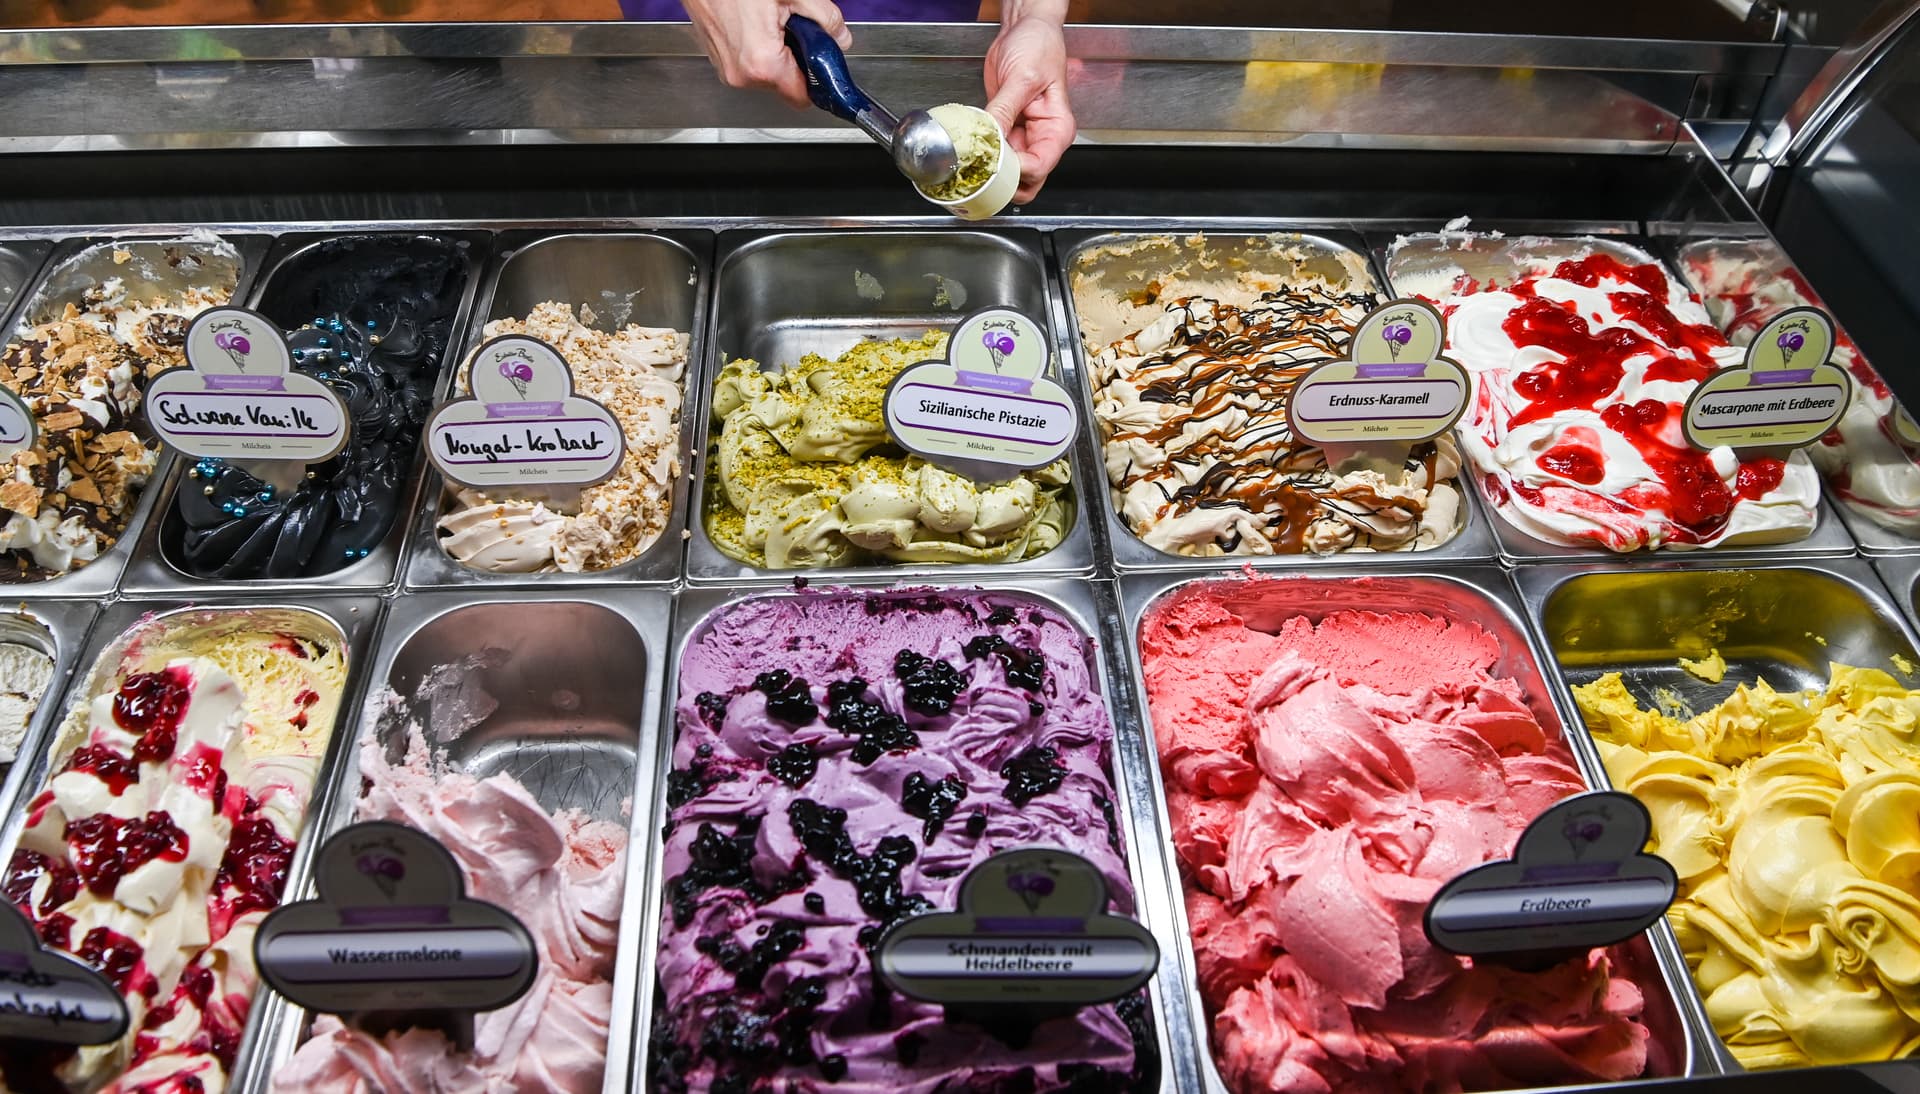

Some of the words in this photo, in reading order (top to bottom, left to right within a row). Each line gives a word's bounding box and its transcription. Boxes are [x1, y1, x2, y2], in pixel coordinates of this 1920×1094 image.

[1328, 392, 1430, 407] Erdnuss-Karamell
[1700, 402, 1765, 416] Mascarpone
[1767, 399, 1785, 412] mit
[1788, 397, 1835, 411] Erdbeere
[918, 400, 996, 422] Sizilianische
[998, 410, 1047, 429] Pistazie
[1362, 425, 1389, 433] Milcheis
[242, 442, 272, 450] Milcheis
[966, 441, 995, 452] Milcheis
[519, 468, 548, 476] Milcheis
[1519, 896, 1592, 913] Erdbeere
[327, 946, 463, 964] Wassermelone
[947, 941, 1056, 957] Schmandeis
[1062, 942, 1093, 957] mit
[965, 957, 1074, 972] Heidelbeere
